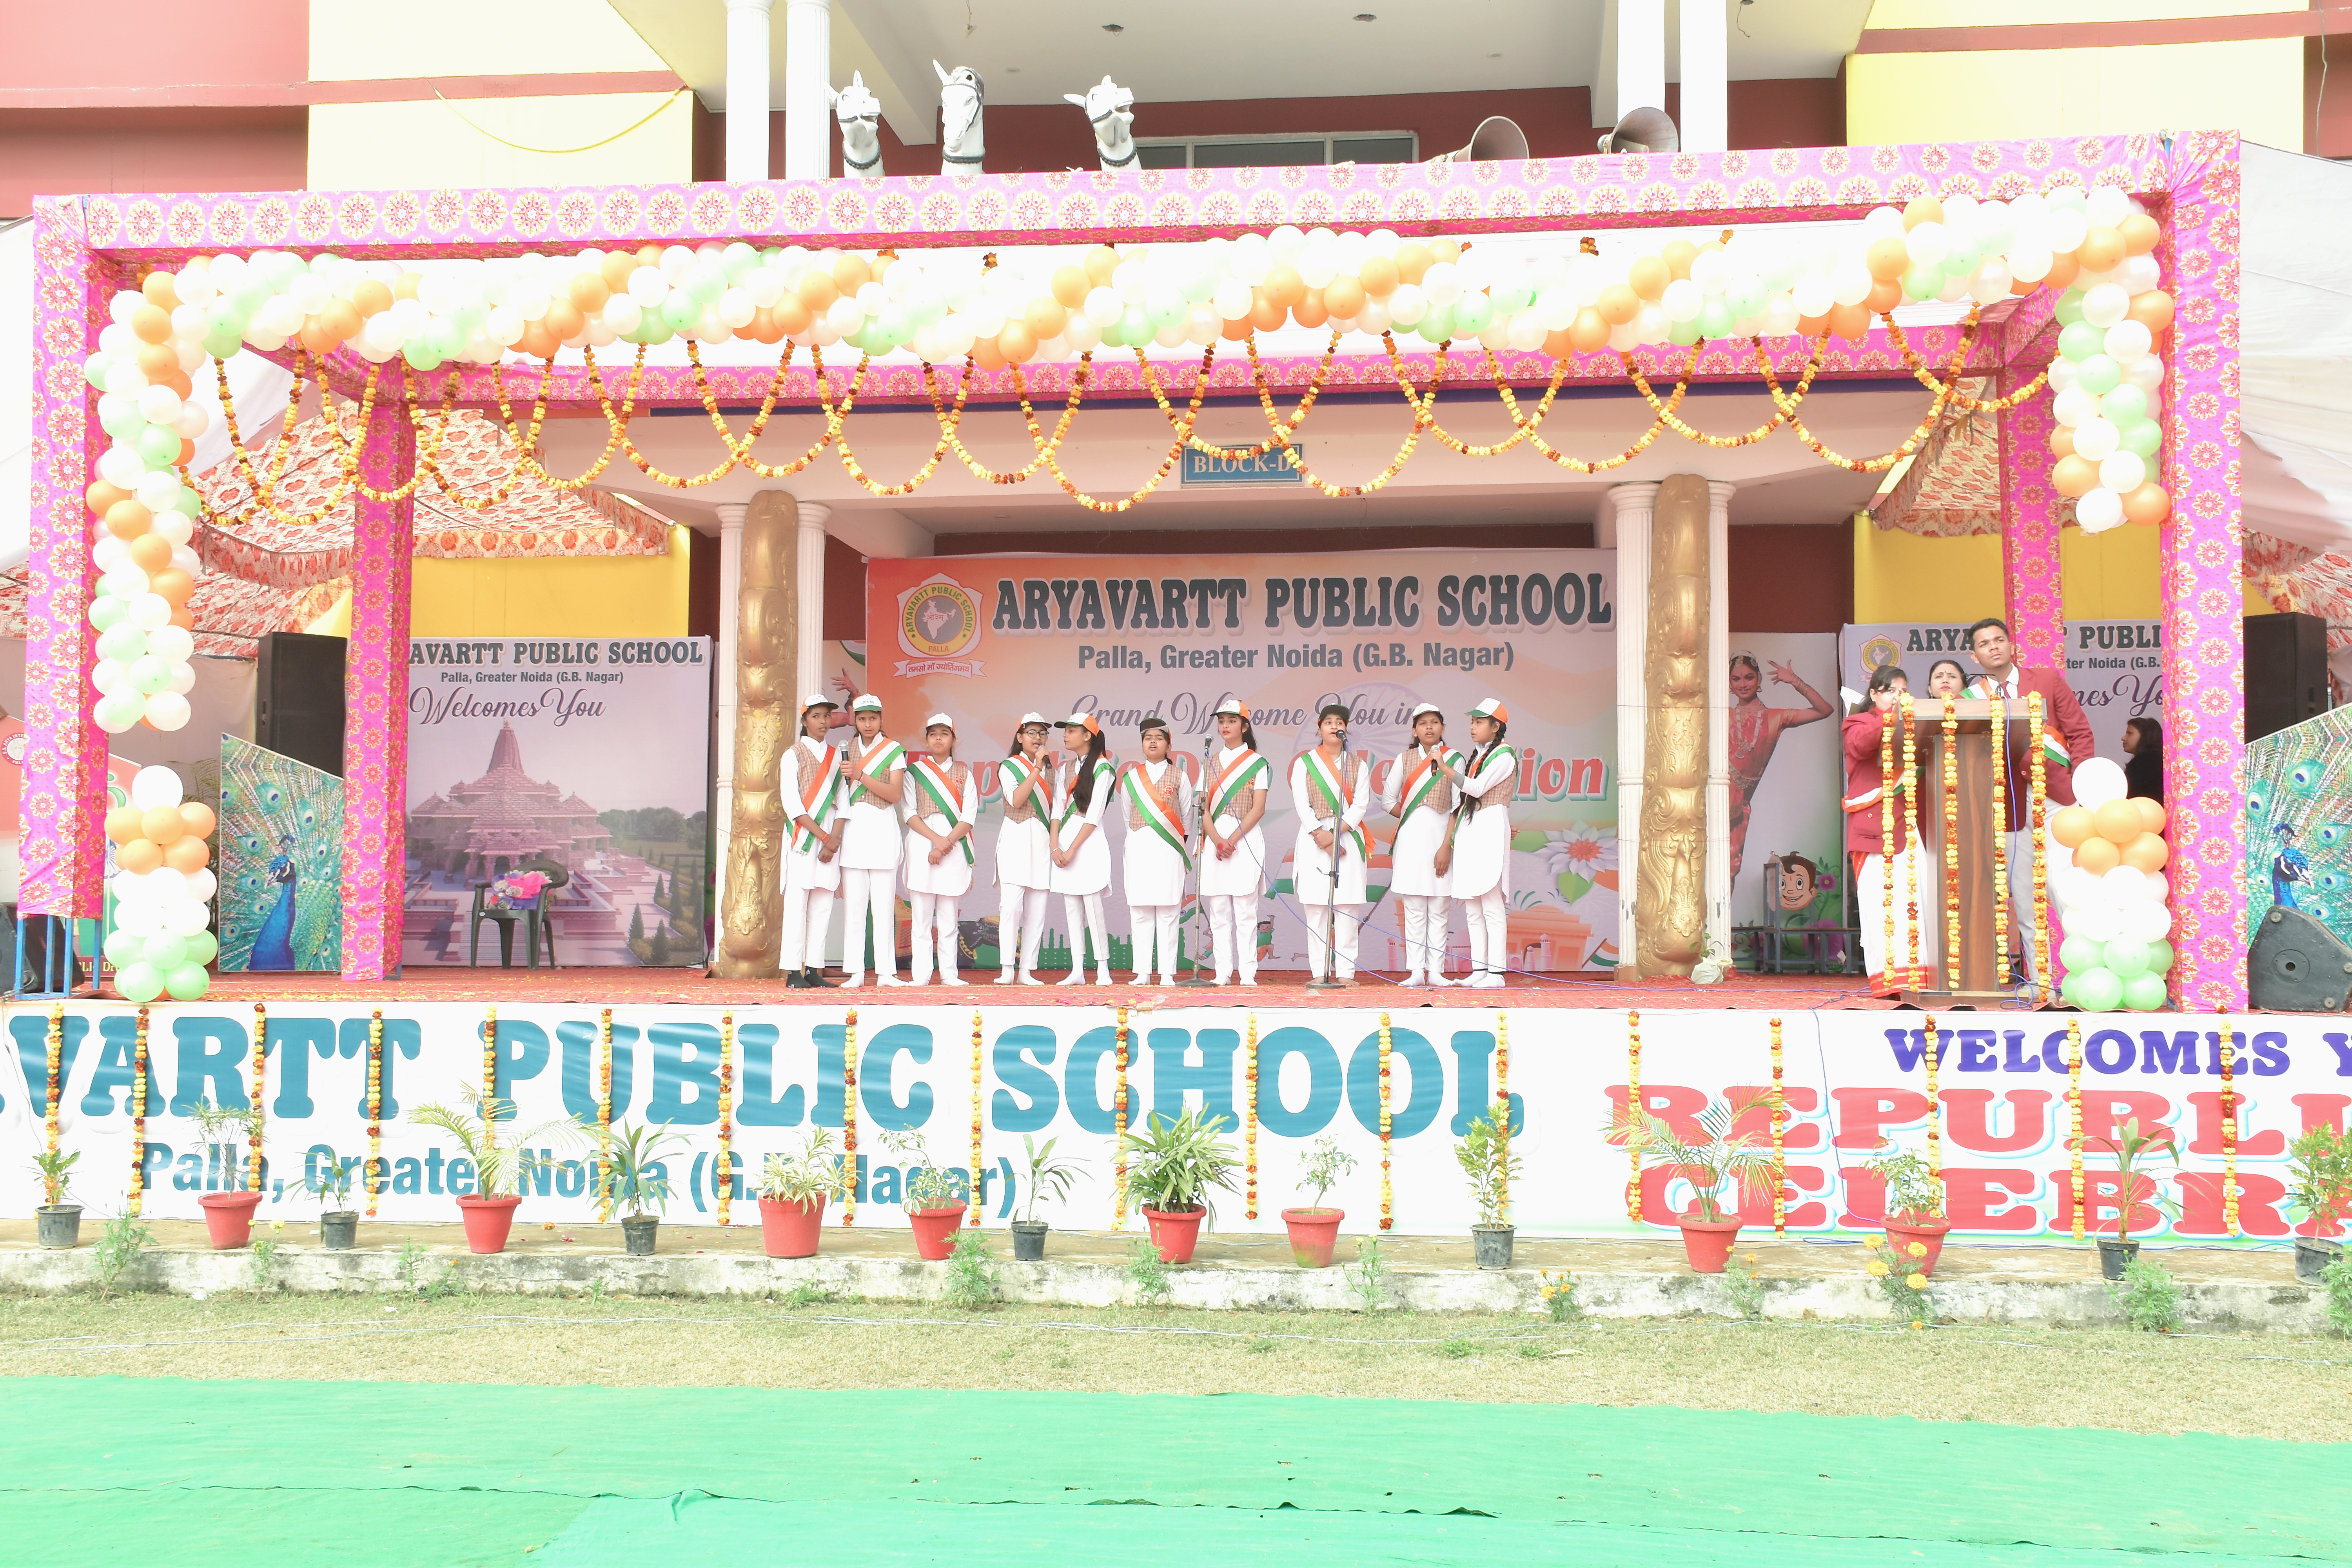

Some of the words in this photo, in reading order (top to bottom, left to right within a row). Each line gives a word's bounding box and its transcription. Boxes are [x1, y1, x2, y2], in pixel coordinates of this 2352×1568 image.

[1193, 455, 1291, 473] BLOCK-D
[906, 589, 929, 632] ARYAVARTT
[931, 586, 962, 601] PUBLIC
[960, 599, 973, 632] SCHOOL
[993, 579, 1247, 630] ARYAVARTT
[1265, 575, 1419, 628] PUBLIC
[1437, 572, 1612, 627] SCHOOL
[513, 642, 599, 664] PUBLIC
[608, 641, 702, 663] SCHOOL
[908, 664, 926, 673] तमसो
[1078, 645, 1151, 674] Palla,
[1160, 644, 1258, 669] Greater
[1267, 643, 1343, 668] Noida
[1352, 643, 1413, 672] (G.B.
[1423, 642, 1514, 672] Nagar)
[2089, 657, 2125, 669] Noida
[2130, 657, 2160, 671] (G.B.
[441, 672, 472, 683] Palla,
[475, 672, 517, 682] Greater
[520, 671, 553, 682] Noida
[556, 671, 582, 684] (G.B.
[586, 671, 624, 684] Nagar)
[409, 686, 541, 725] Welcomes
[540, 687, 606, 727] You
[1171, 691, 1308, 735] Wome
[1884, 1029, 2290, 1076] WELCOMES
[0, 1015, 421, 1120] VARTT
[477, 1020, 934, 1132] PUBLIC
[991, 1025, 1524, 1139] SCHOOL
[142, 1142, 284, 1203] Palla,
[305, 1144, 485, 1195] Greate
